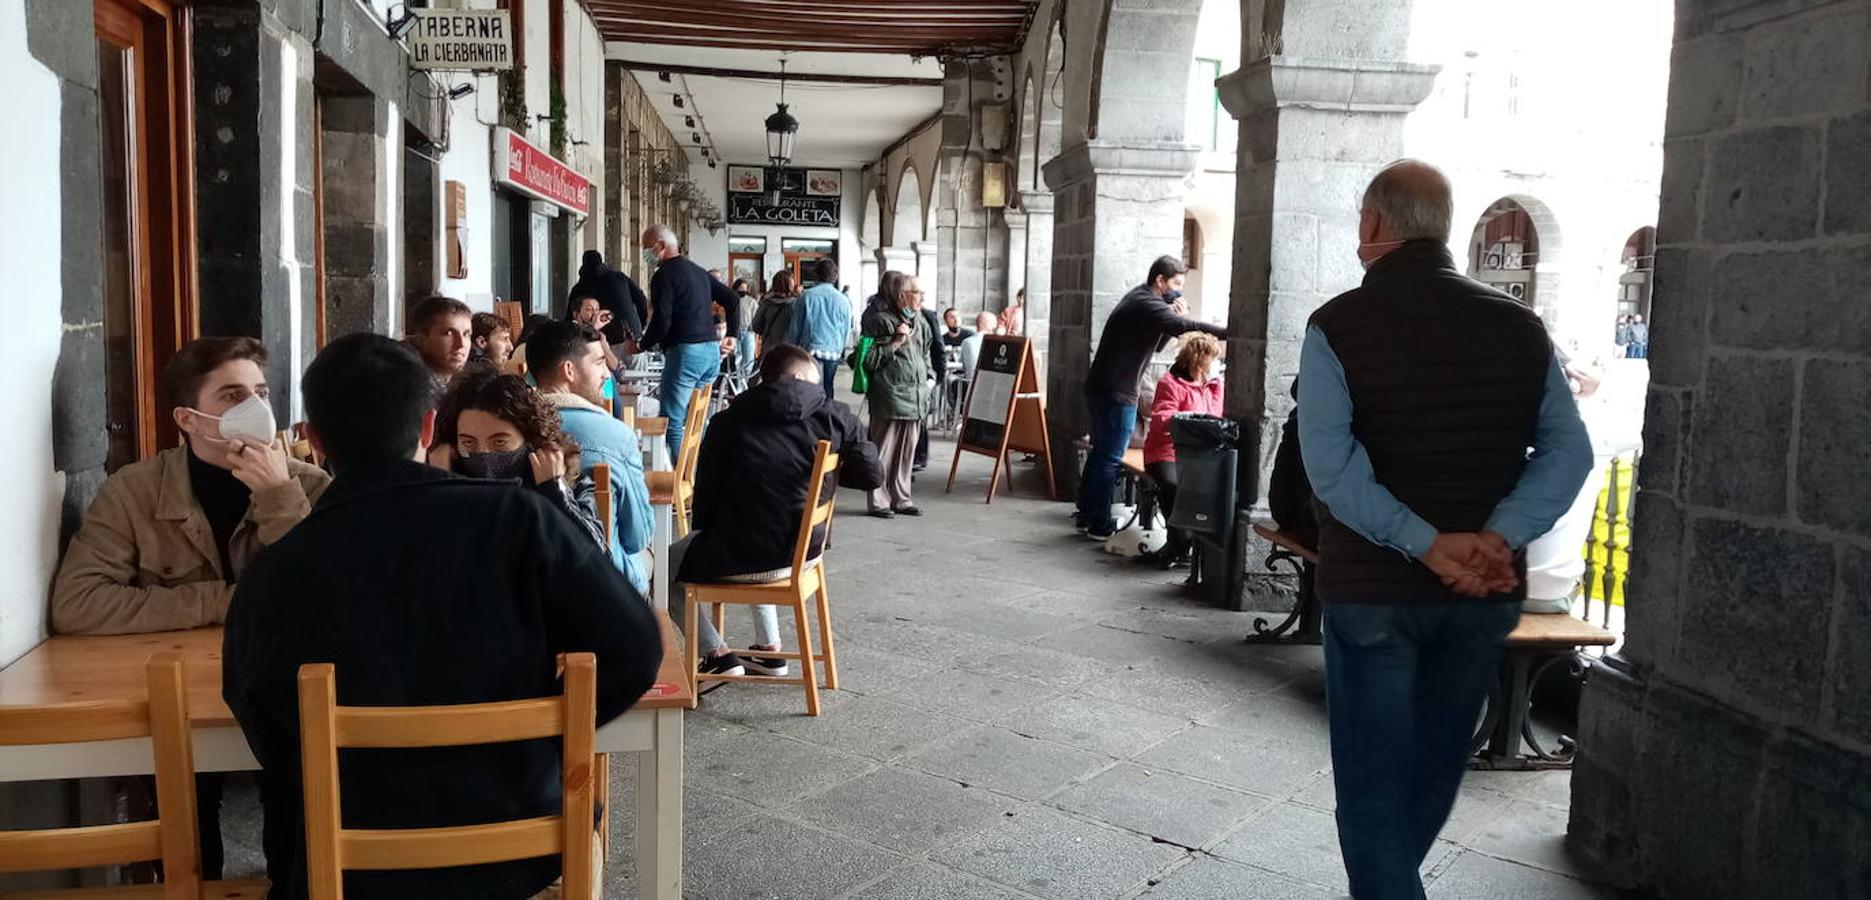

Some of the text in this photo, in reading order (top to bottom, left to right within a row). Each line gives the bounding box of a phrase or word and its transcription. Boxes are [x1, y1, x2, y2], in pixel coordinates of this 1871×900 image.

[418, 16, 502, 38] TABERNA
[415, 43, 507, 62] LA CIERBANATA
[752, 198, 817, 209] RESTURANTE
[736, 206, 834, 222] LA GOLETA
